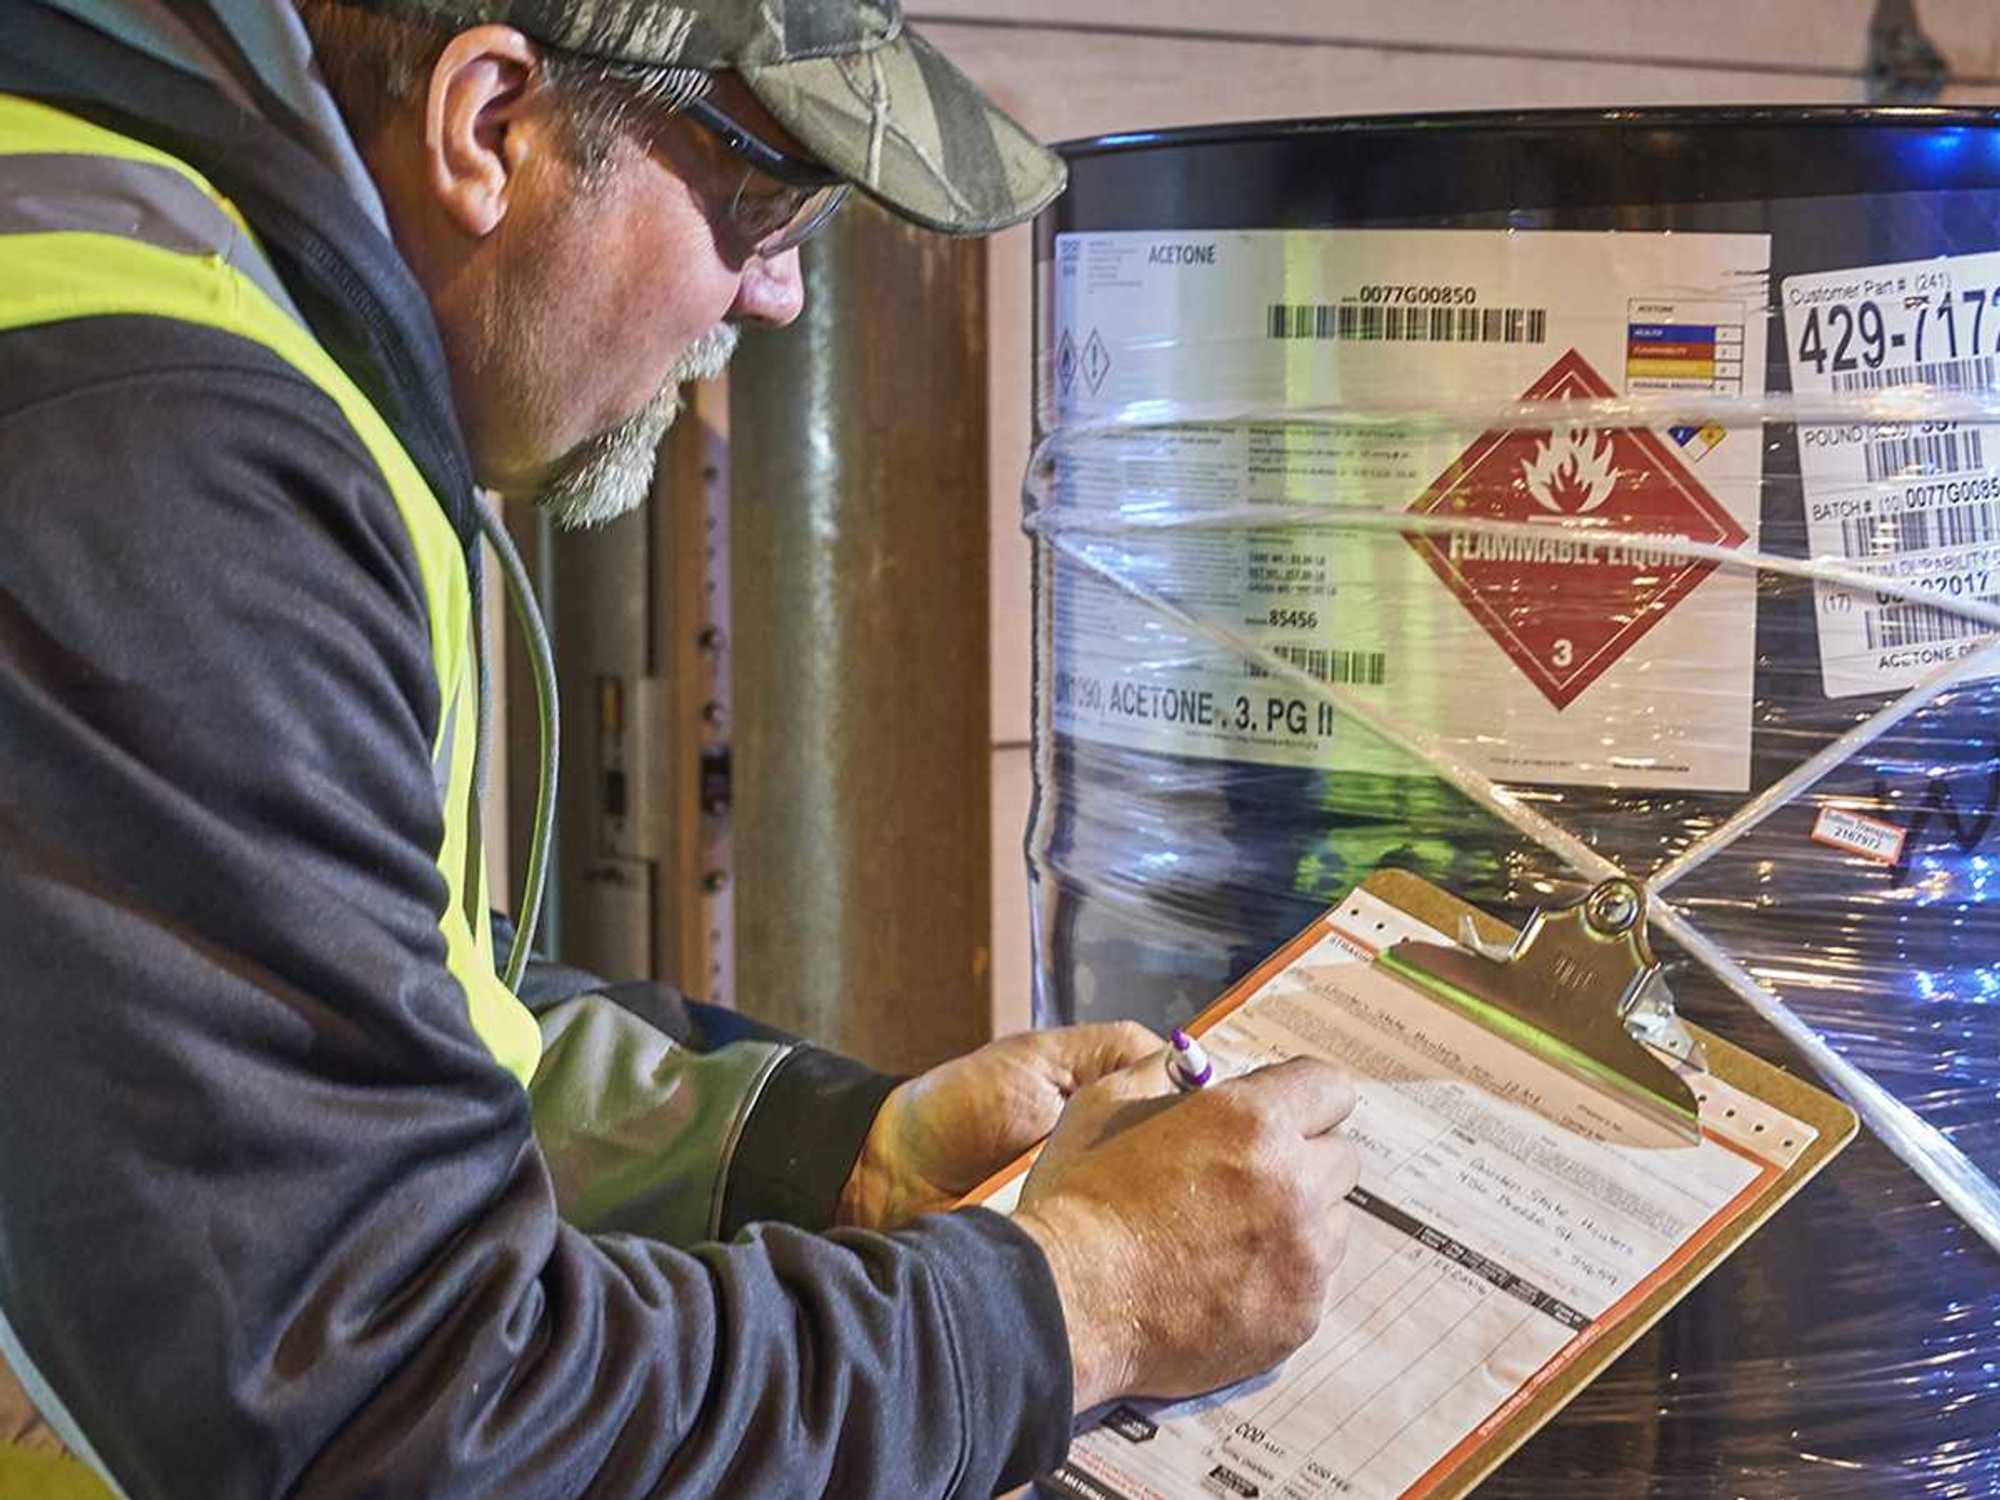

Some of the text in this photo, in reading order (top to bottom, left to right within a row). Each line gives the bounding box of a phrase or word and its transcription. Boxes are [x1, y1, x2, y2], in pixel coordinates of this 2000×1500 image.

[1149, 244, 1216, 265] ACETONE
[1360, 286, 1477, 304] 0077G00850
[1790, 284, 1859, 305] Customer
[1864, 280, 1894, 294] Part
[1805, 426, 1863, 448] POUND
[1813, 500, 1862, 521] BATCH
[1450, 530, 1600, 564] FLAMMABLE
[1824, 594, 1851, 614] (17)
[1269, 610, 1318, 628] 85456
[1551, 639, 1573, 667] 3
[1878, 647, 1954, 669] ACETONE
[1110, 678, 1213, 725] ACETONE
[1267, 700, 1307, 736] PG
[1318, 702, 1333, 736] II
[1235, 1421, 1266, 1444] COD
